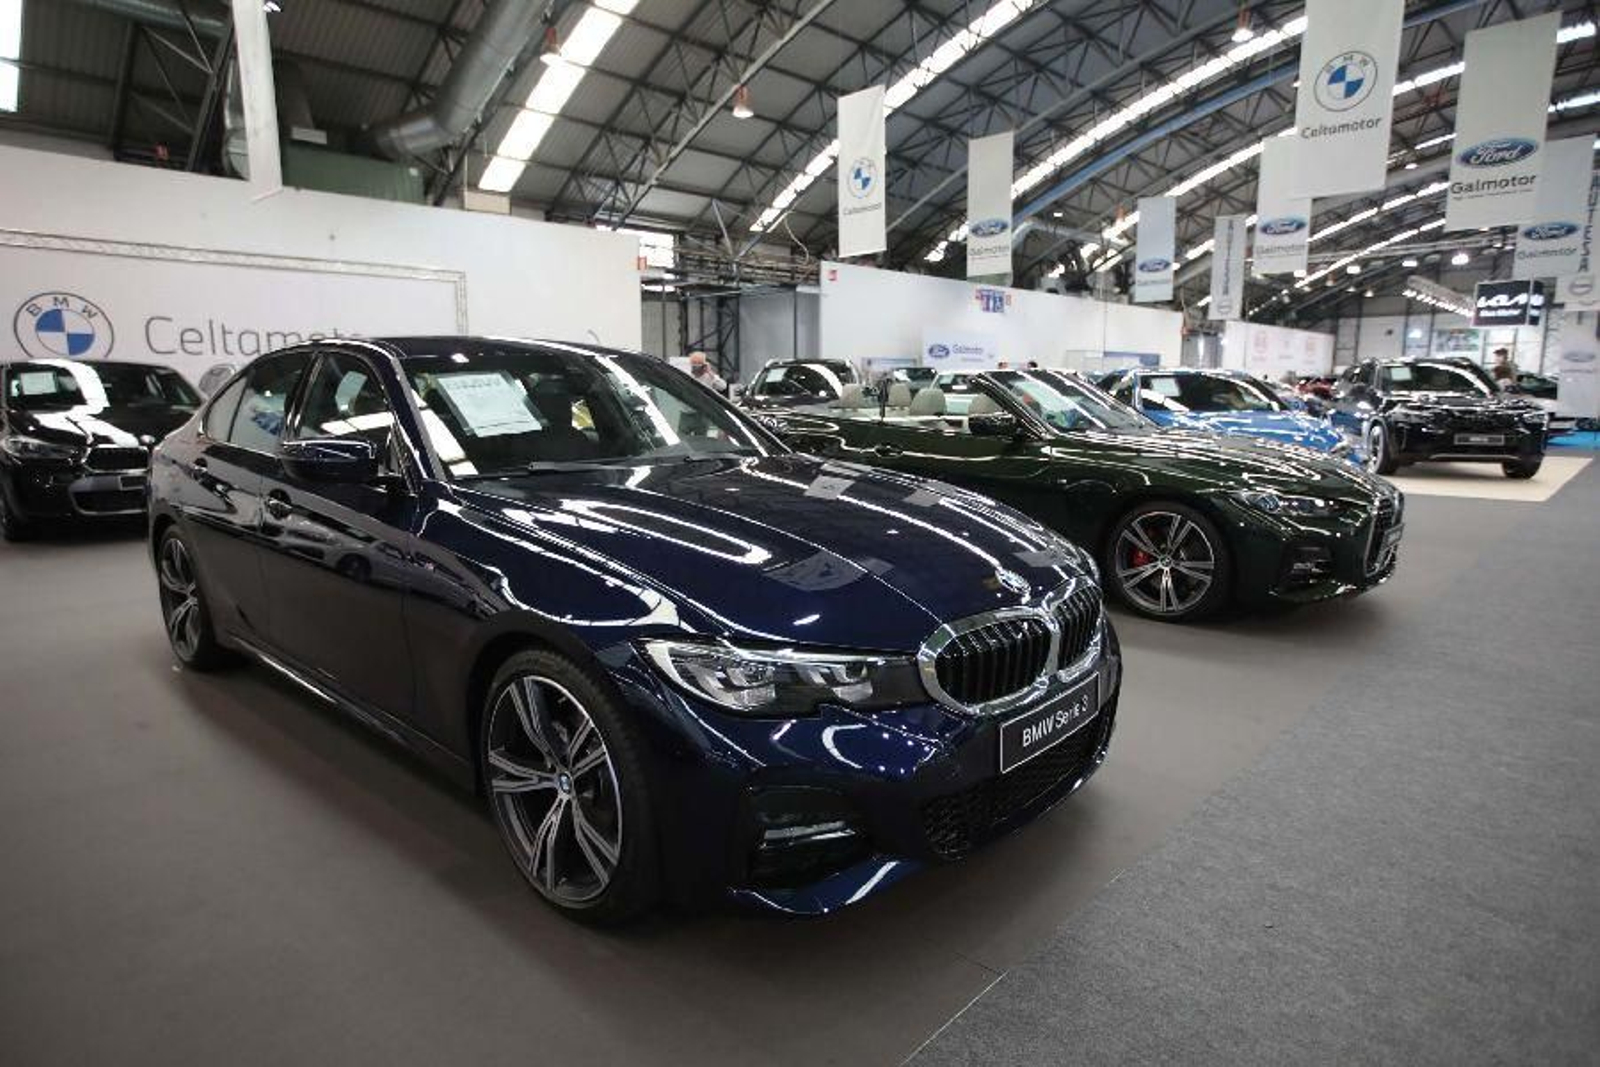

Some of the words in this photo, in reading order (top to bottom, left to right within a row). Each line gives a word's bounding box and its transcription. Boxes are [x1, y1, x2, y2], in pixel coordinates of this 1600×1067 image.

[1301, 117, 1381, 139] Celtamotor
[1469, 143, 1526, 165] Ford
[1451, 174, 1536, 195] Galmotor
[26, 296, 98, 319] BMW
[1023, 715, 1054, 746] BMW
[1055, 703, 1080, 729] Serie
[1082, 695, 1088, 711] 3
